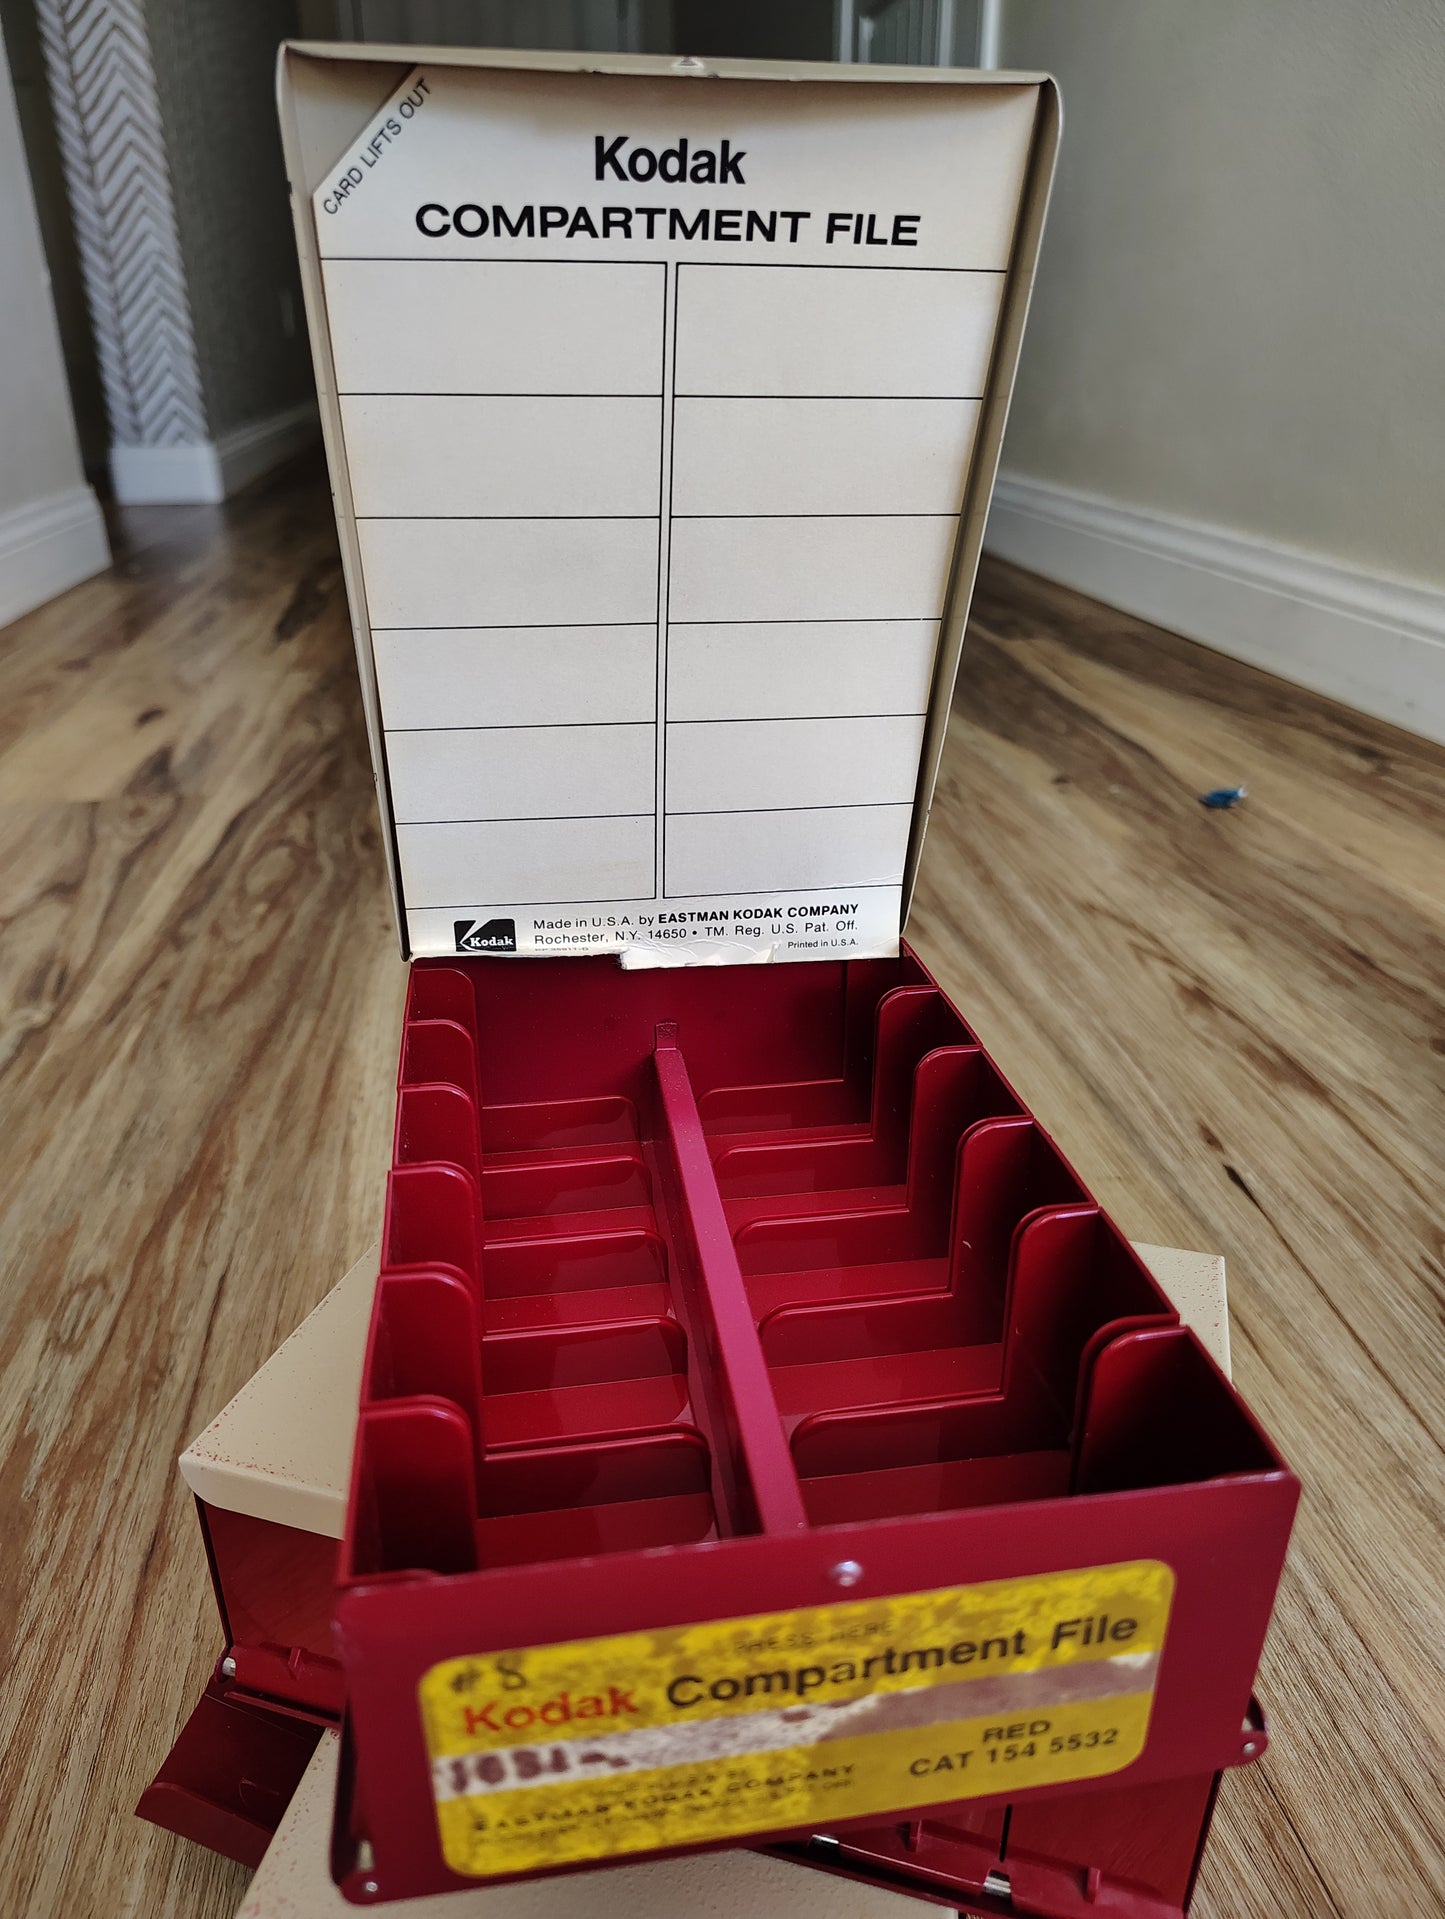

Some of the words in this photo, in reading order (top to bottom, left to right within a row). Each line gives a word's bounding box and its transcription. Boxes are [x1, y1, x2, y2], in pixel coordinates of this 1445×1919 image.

[323, 165, 363, 215] CARD
[360, 118, 402, 168] LIFTS
[400, 77, 432, 120] OUT
[594, 135, 748, 185] Kodak
[415, 203, 812, 243] COMPARTMENT
[825, 212, 922, 247] FILE
[533, 919, 572, 930] Made
[575, 918, 588, 928] in
[592, 915, 634, 928] U.S.A.
[639, 914, 655, 926] by
[658, 910, 730, 924] EASTMAN
[733, 907, 784, 920] KODAK
[787, 903, 859, 918] COMPANY
[469, 935, 515, 947] Kodak
[534, 932, 609, 945] Rochester,
[615, 930, 641, 941] N.Y.
[649, 928, 687, 940] 14650
[705, 926, 728, 937] TM.
[735, 925, 764, 938] Reg.
[771, 923, 798, 935] U.S.
[805, 921, 829, 933] Pat.
[836, 920, 858, 932] Off.
[787, 939, 819, 949] Printed
[820, 939, 829, 948] in
[830, 938, 859, 947] U.S.A.
[462, 1685, 640, 1737] Kodak
[666, 1628, 1027, 1710] Compartment
[1050, 1613, 1140, 1652] File
[982, 1719, 1053, 1744] RED
[908, 1750, 974, 1778] CAT
[989, 1741, 1038, 1764] 154
[1049, 1727, 1120, 1755] 5532
[726, 1763, 856, 1794] COMPANY
